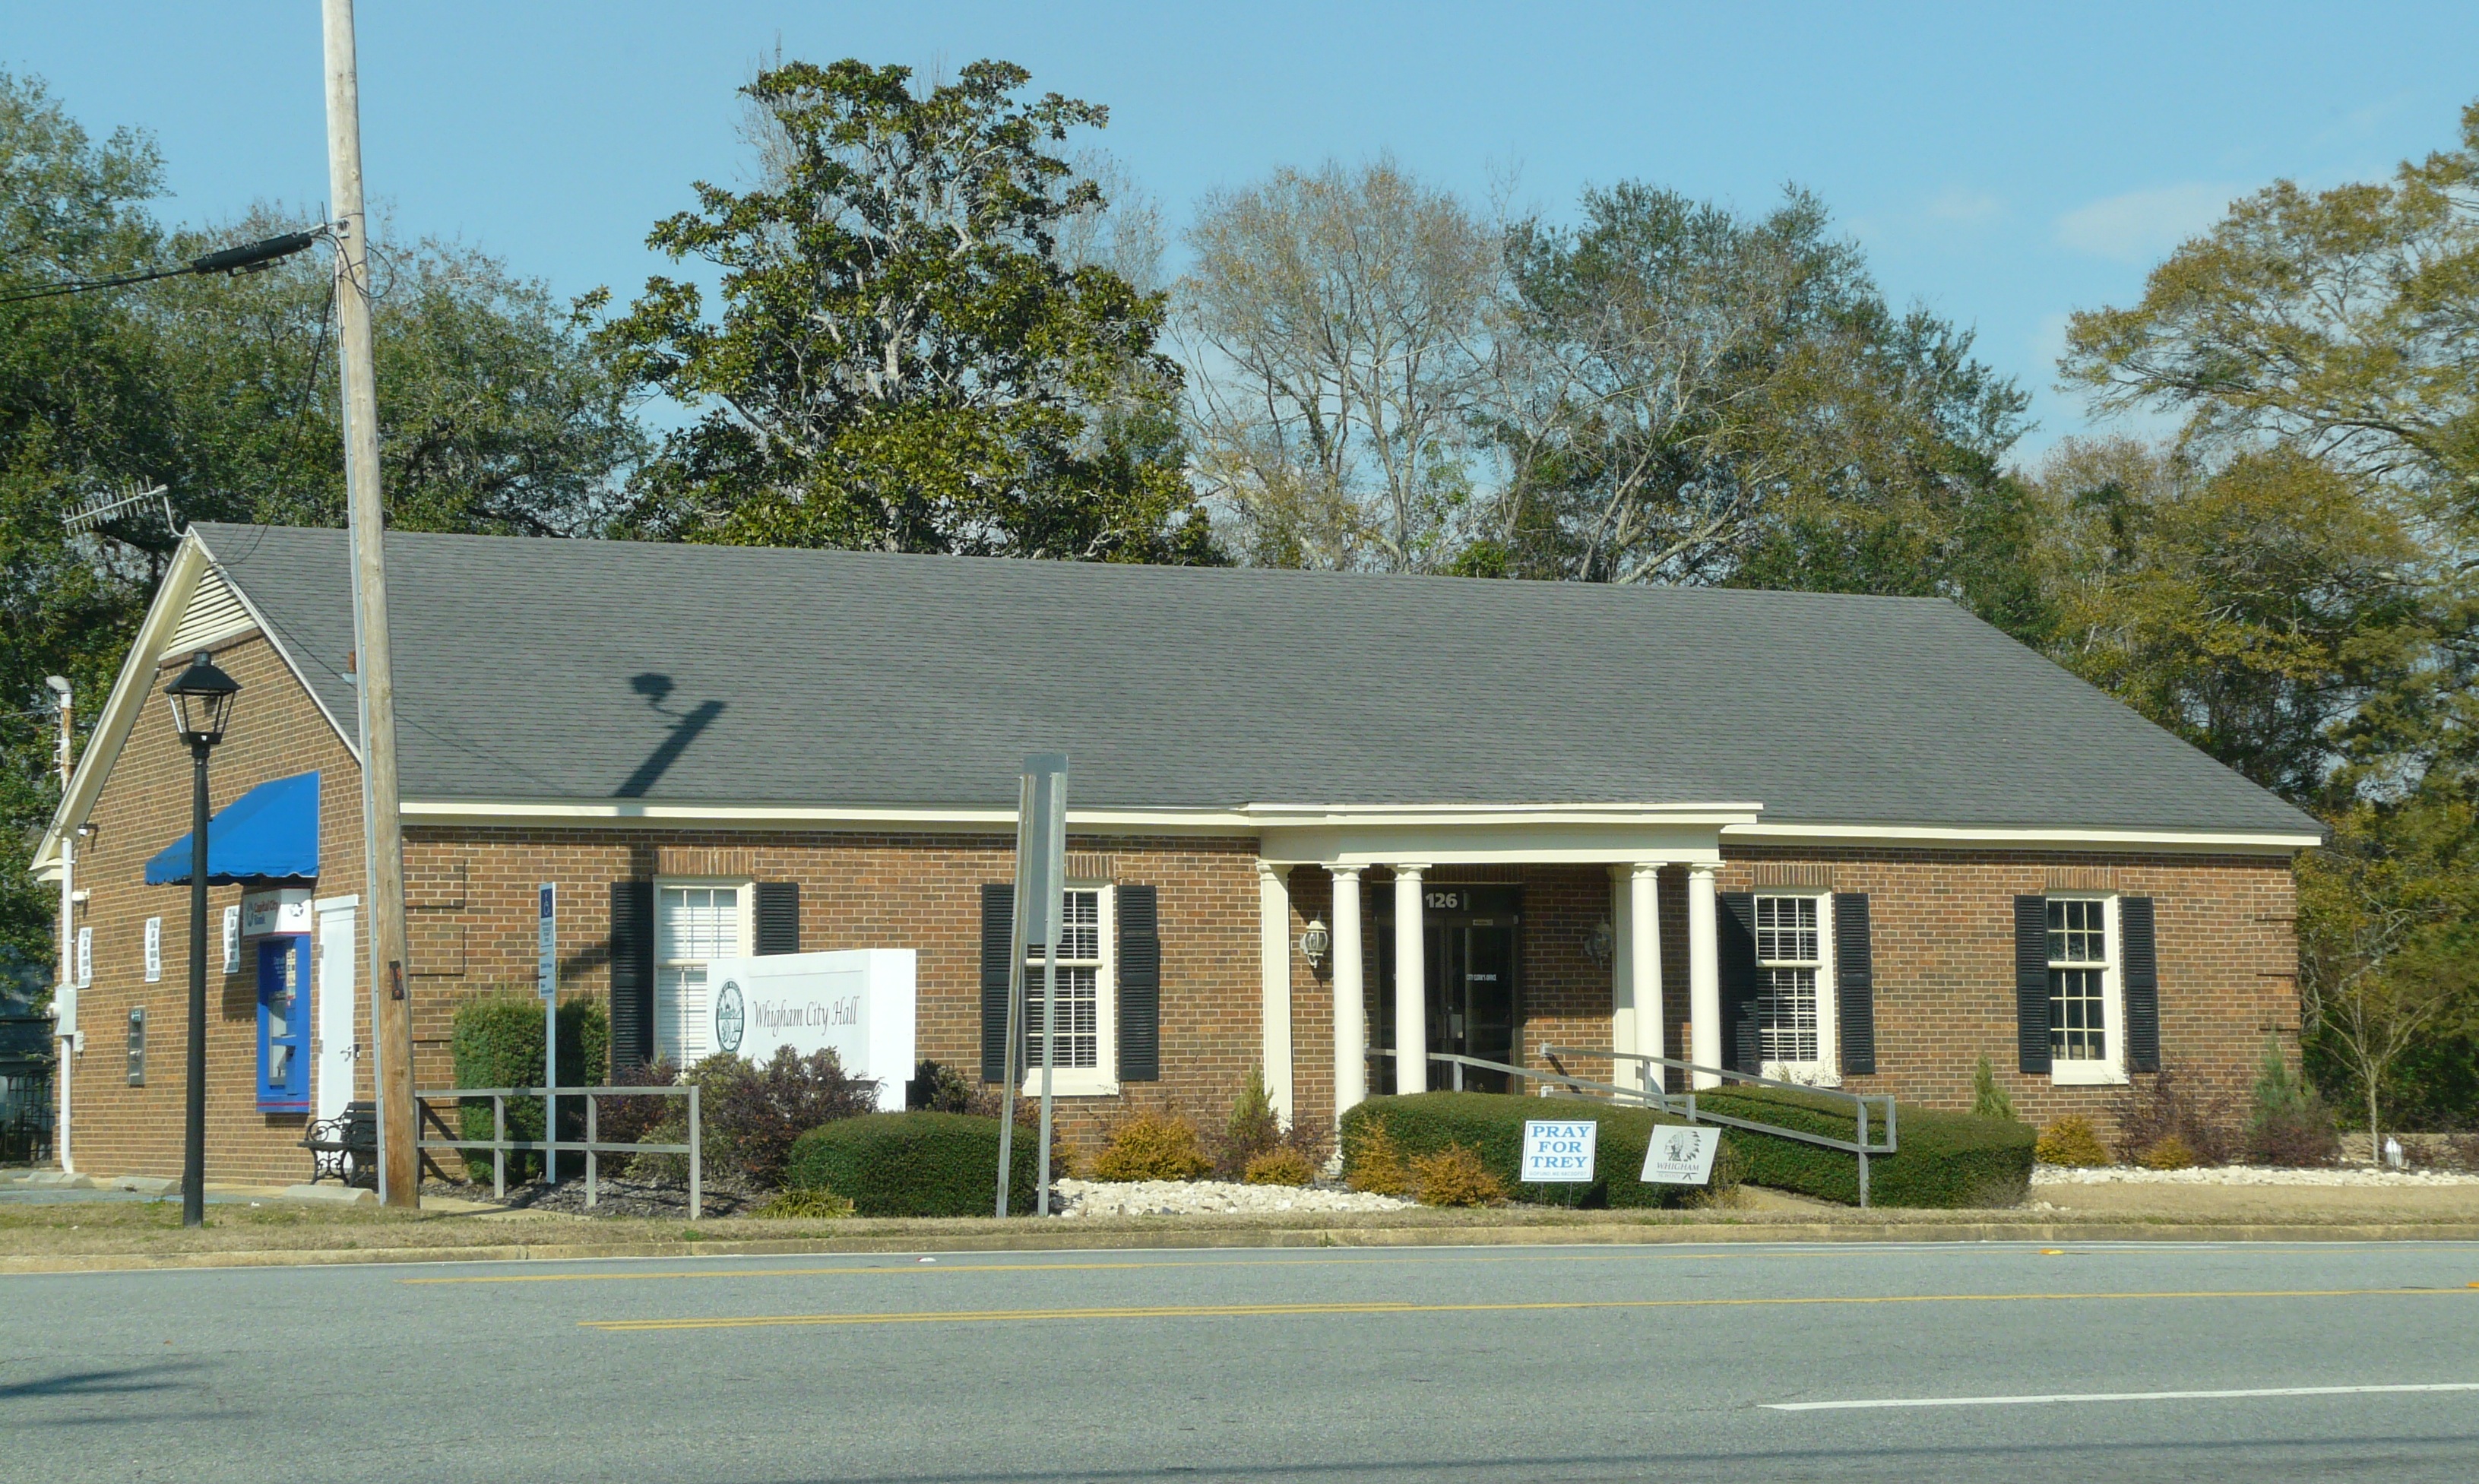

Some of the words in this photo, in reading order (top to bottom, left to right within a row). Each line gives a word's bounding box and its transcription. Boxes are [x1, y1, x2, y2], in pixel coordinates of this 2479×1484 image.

[1425, 892, 1458, 908] 126
[753, 999, 803, 1037] Whigham
[806, 1000, 828, 1036] City
[831, 995, 860, 1026] Hall
[1531, 1125, 1591, 1138] PRAY
[1537, 1141, 1582, 1153] FOR
[1530, 1156, 1588, 1168] TREY
[1657, 1162, 1699, 1171] WHIGHAM
